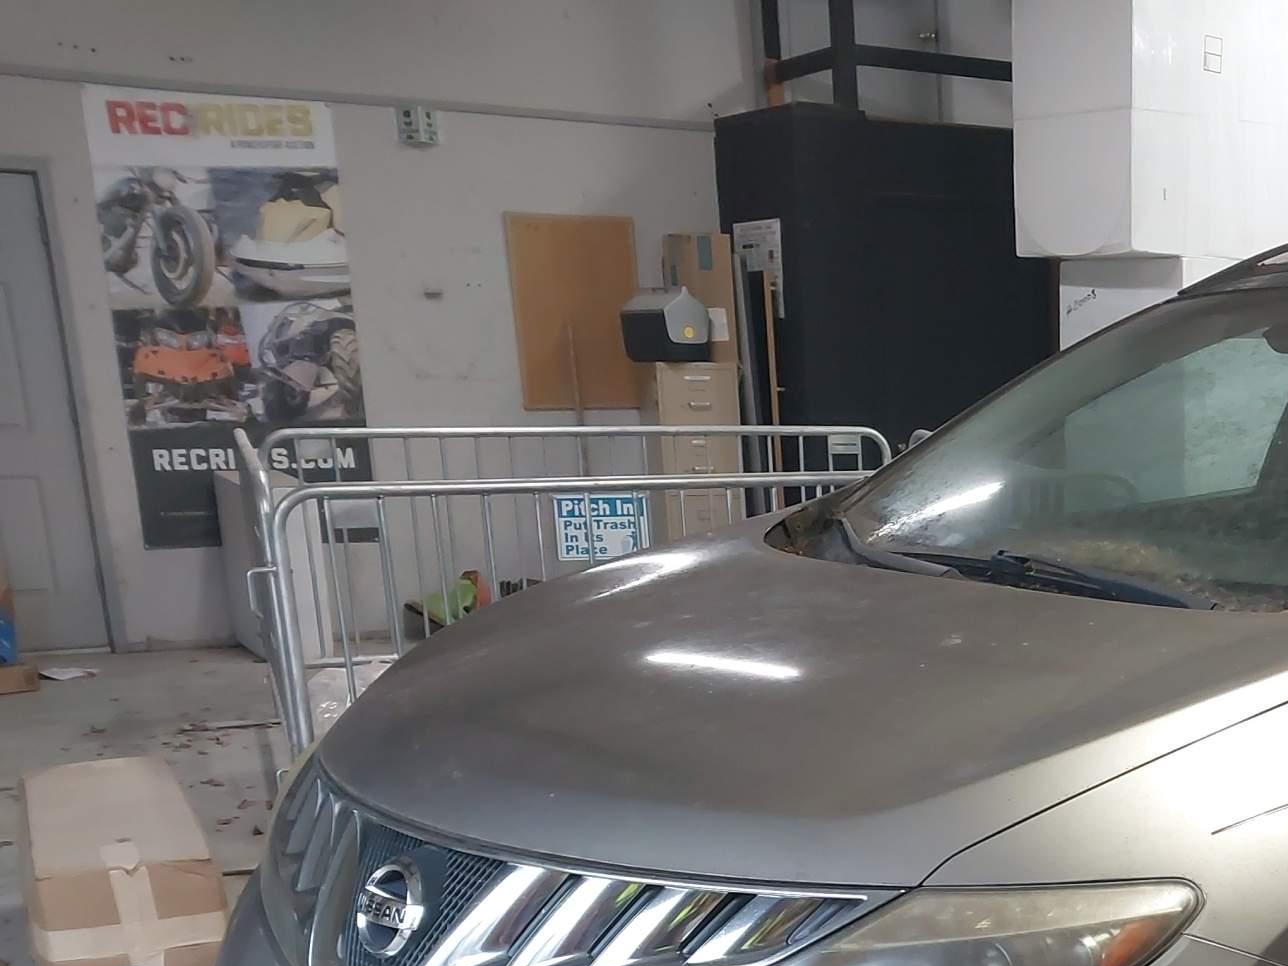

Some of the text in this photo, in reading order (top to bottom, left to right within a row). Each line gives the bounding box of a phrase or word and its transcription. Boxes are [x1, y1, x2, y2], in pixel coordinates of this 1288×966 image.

[106, 99, 190, 136] REC
[152, 448, 356, 471] RECRIS.COM
[615, 499, 634, 515] In
[593, 518, 637, 530] Trash
[565, 532, 579, 543] In
